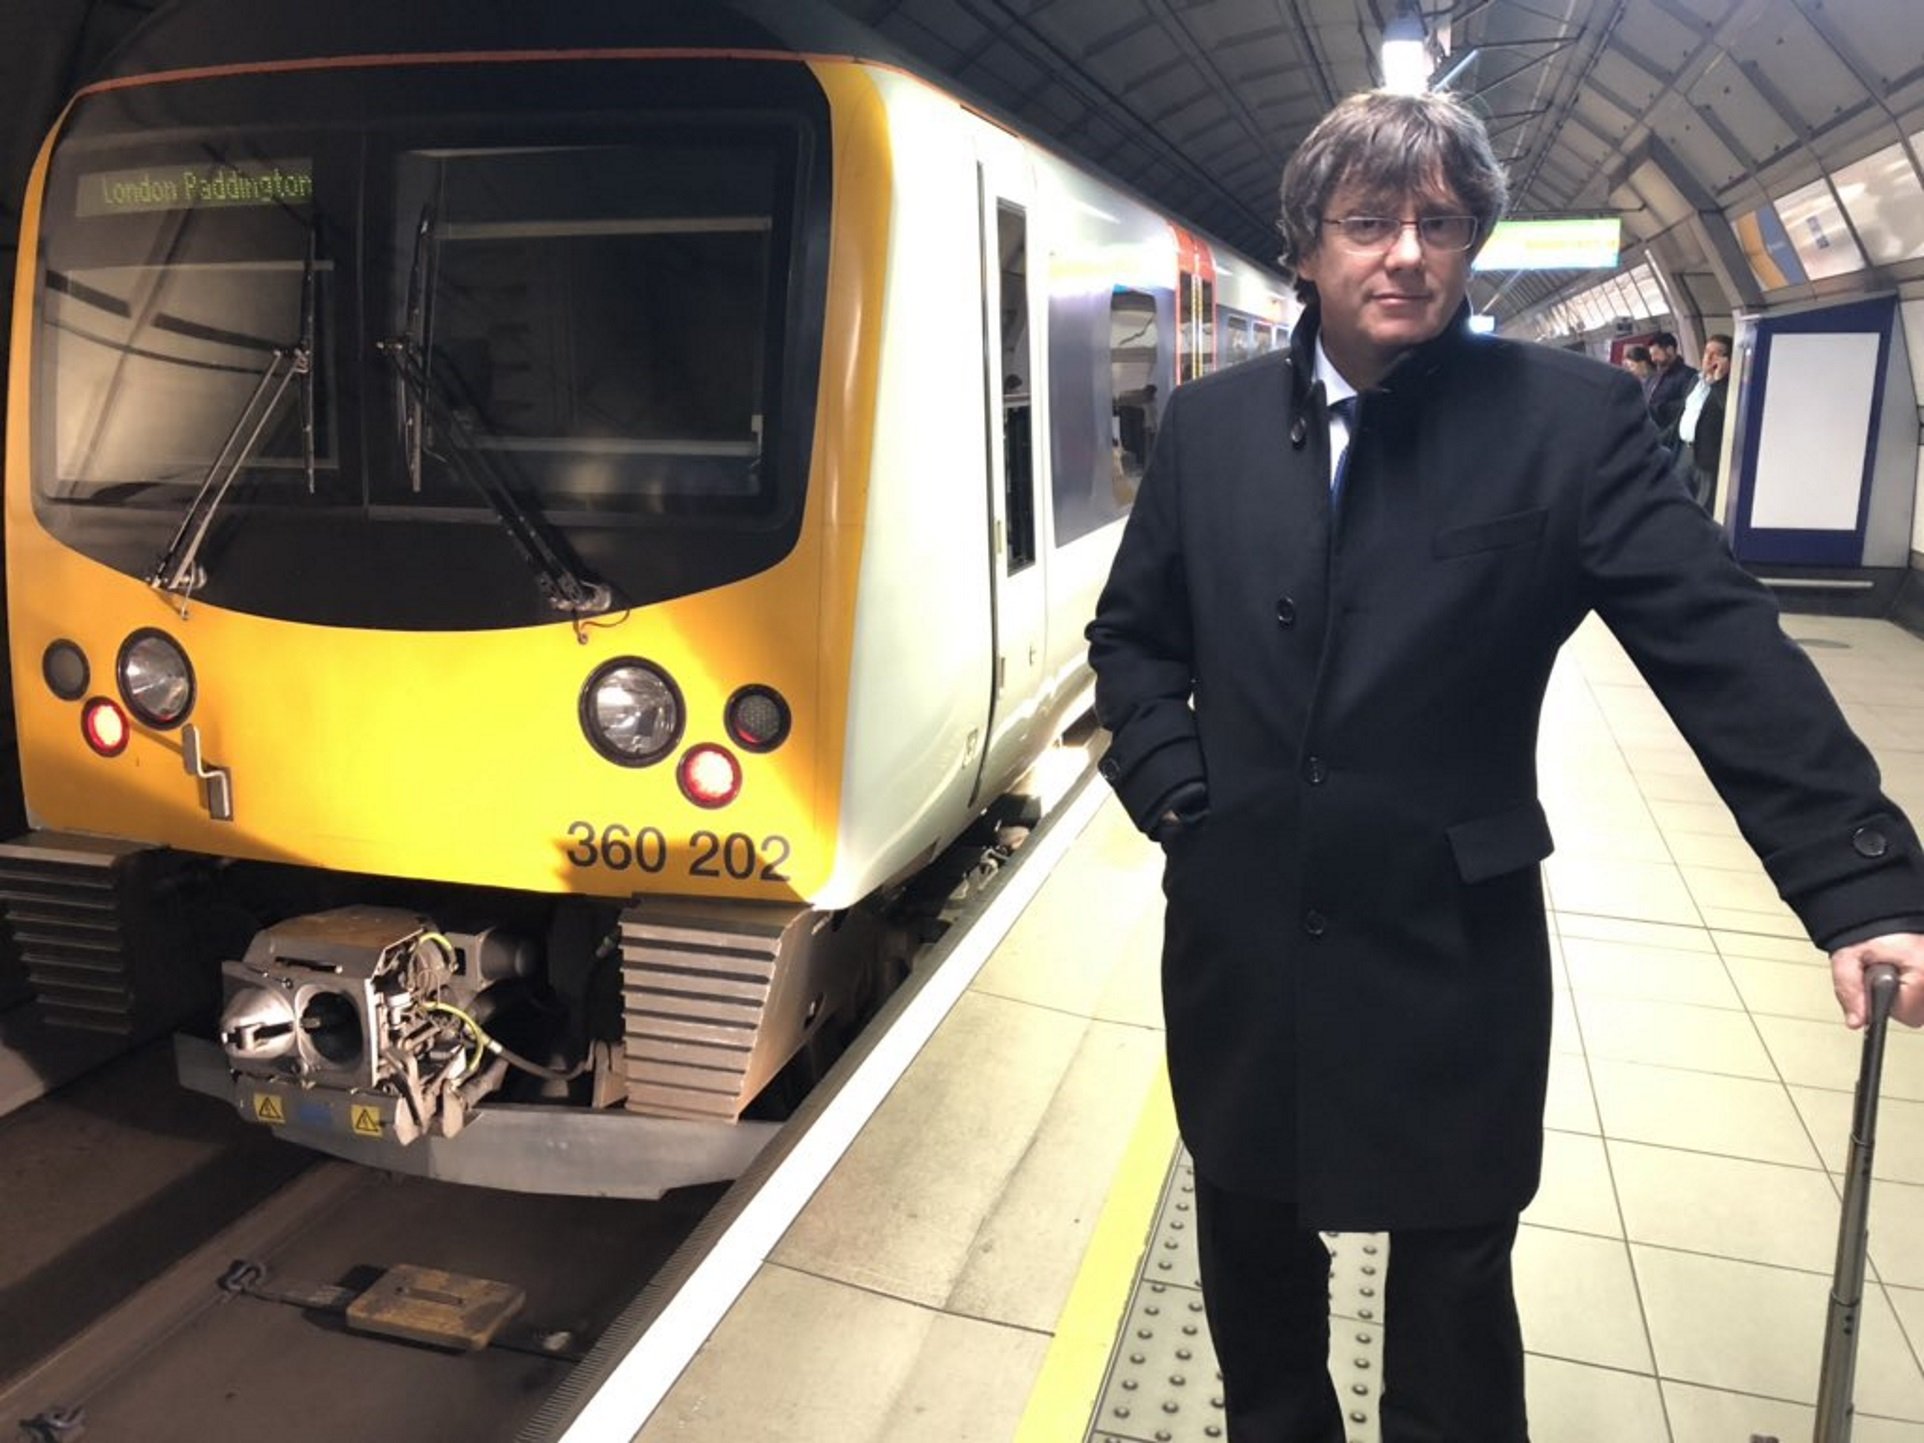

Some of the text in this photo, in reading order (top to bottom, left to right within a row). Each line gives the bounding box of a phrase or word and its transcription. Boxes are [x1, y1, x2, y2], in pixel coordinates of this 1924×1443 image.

[102, 168, 312, 205] London Paddington
[566, 820, 791, 882] 360 202
